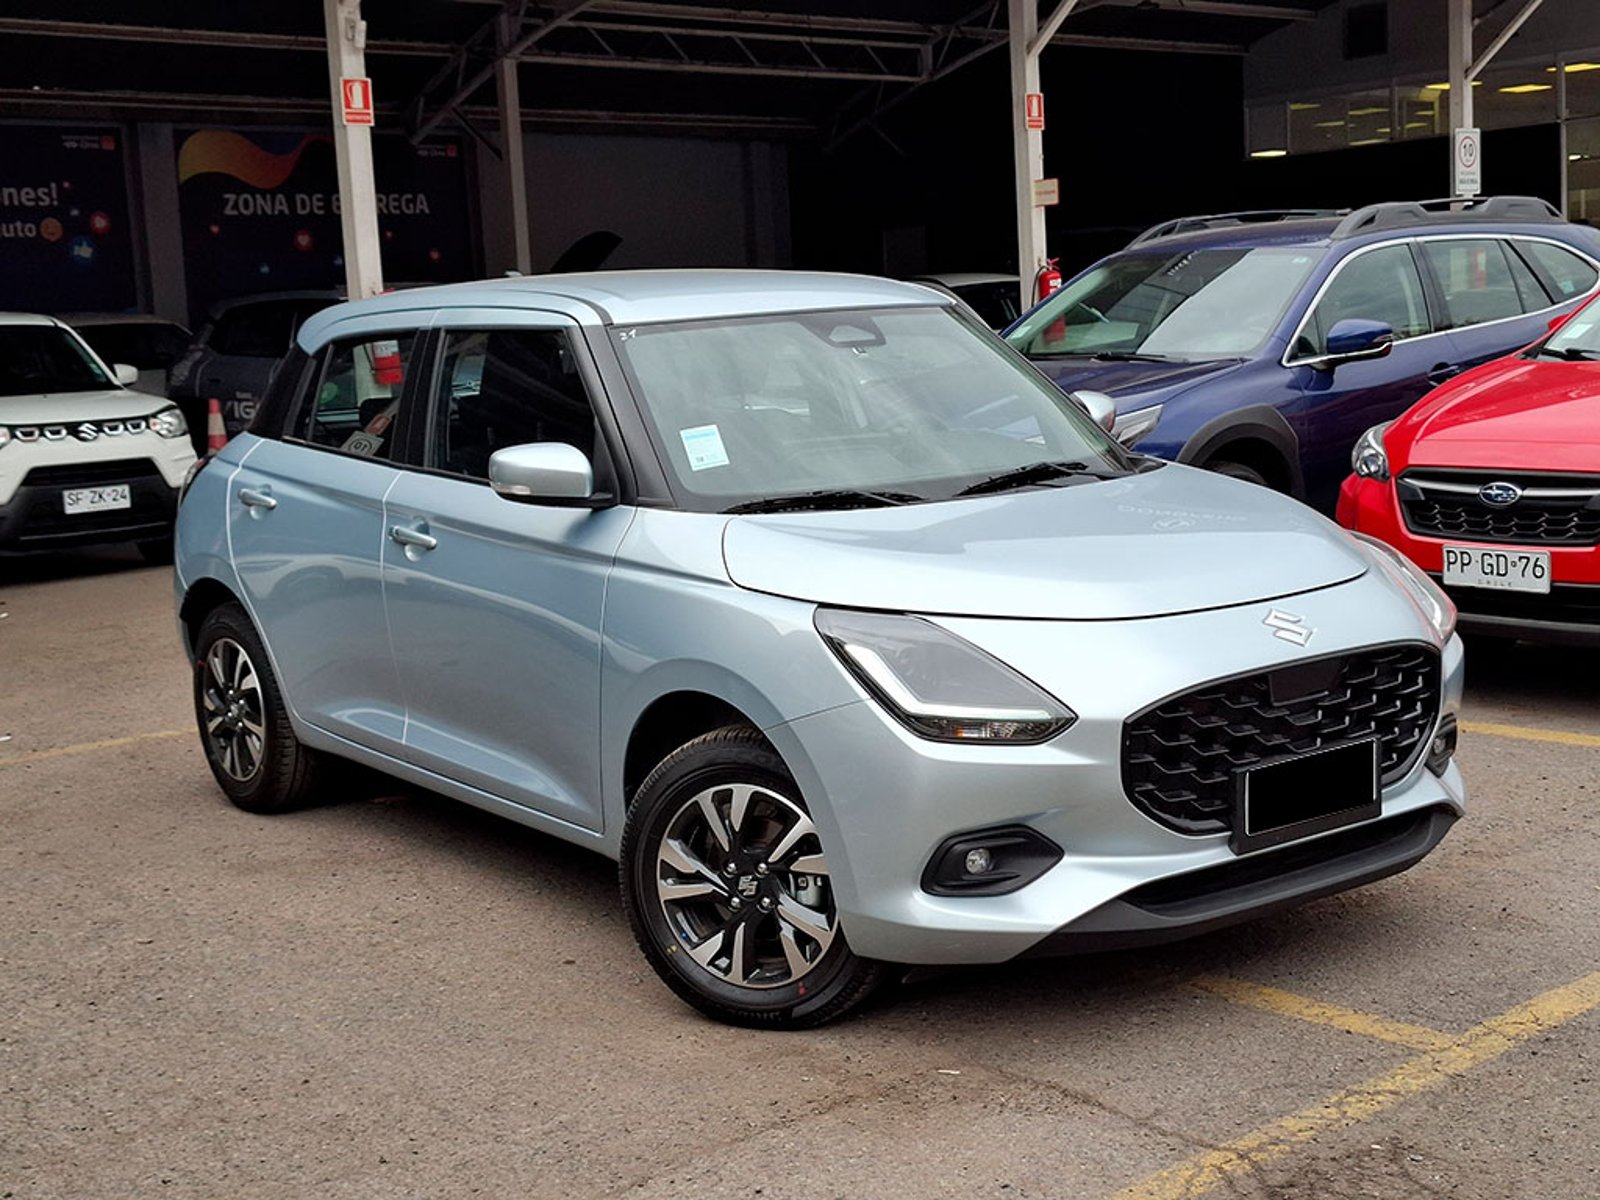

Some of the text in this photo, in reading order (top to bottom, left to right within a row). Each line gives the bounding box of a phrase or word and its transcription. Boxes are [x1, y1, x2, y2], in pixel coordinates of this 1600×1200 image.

[1, 181, 59, 207] nes!
[222, 192, 430, 216] ZONA DE EREGA
